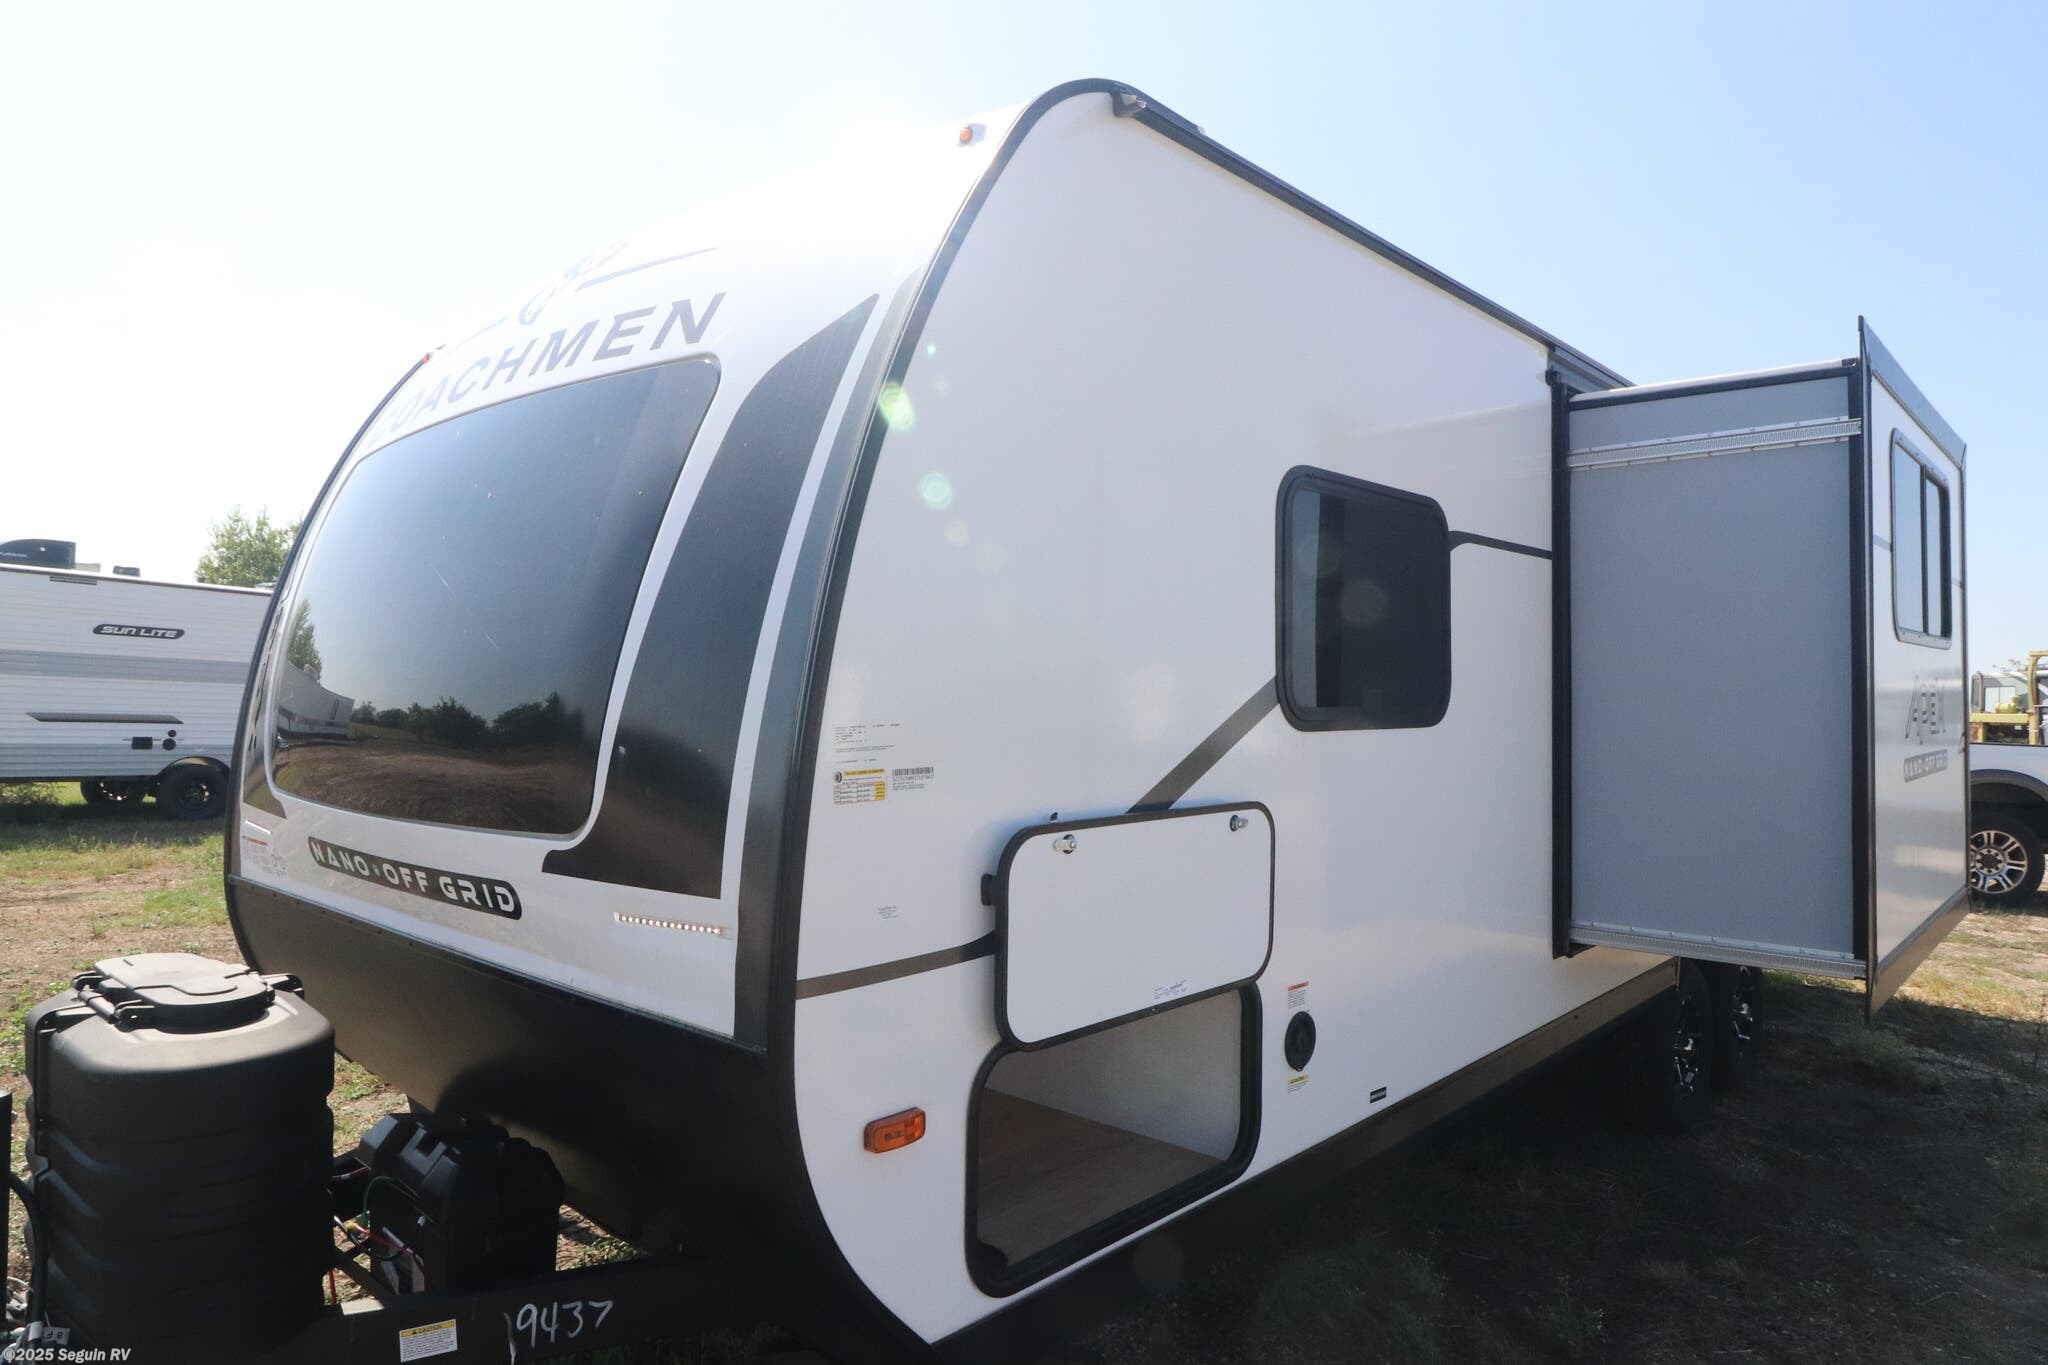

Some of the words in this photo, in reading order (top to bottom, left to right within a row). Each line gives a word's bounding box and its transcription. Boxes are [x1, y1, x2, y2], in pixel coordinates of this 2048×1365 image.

[140, 628, 178, 638] LITE
[1905, 673, 1946, 745] APEX
[311, 841, 370, 877] NANO
[382, 863, 429, 893] OFF
[439, 876, 515, 913] GRID
